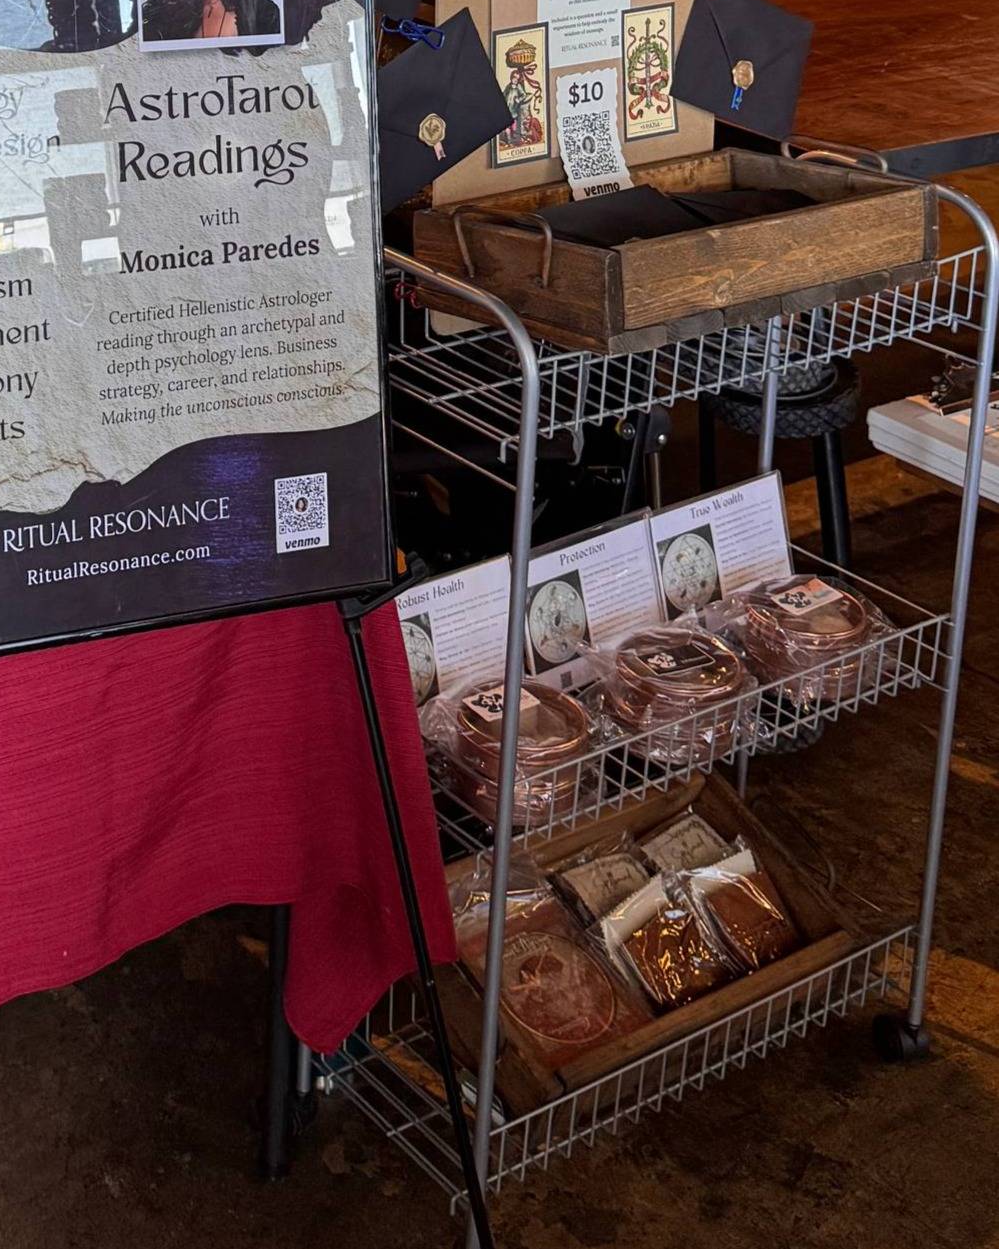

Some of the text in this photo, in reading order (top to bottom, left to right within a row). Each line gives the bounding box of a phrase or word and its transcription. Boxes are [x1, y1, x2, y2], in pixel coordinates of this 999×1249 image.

[568, 81, 604, 108] $10
[118, 134, 310, 189] Readings
[583, 181, 621, 197] venmo
[200, 207, 240, 227] with
[118, 235, 320, 274] Monica Paredes
[108, 290, 333, 325] Certified Hellenistic Astrologer
[96, 310, 345, 351] reading through an archetypal and
[106, 337, 338, 377] depth psychology lens. Business
[99, 360, 346, 401] strategy, career, and relationships.
[101, 384, 345, 426] Making the unconscious conscious.
[3, 496, 231, 553] RITUAL RESONANCE
[689, 491, 745, 521] True Wealth
[285, 535, 321, 550] venmo
[559, 541, 606, 566] Protection
[27, 544, 212, 586] RitualResonance.com
[432, 579, 466, 600] Health
